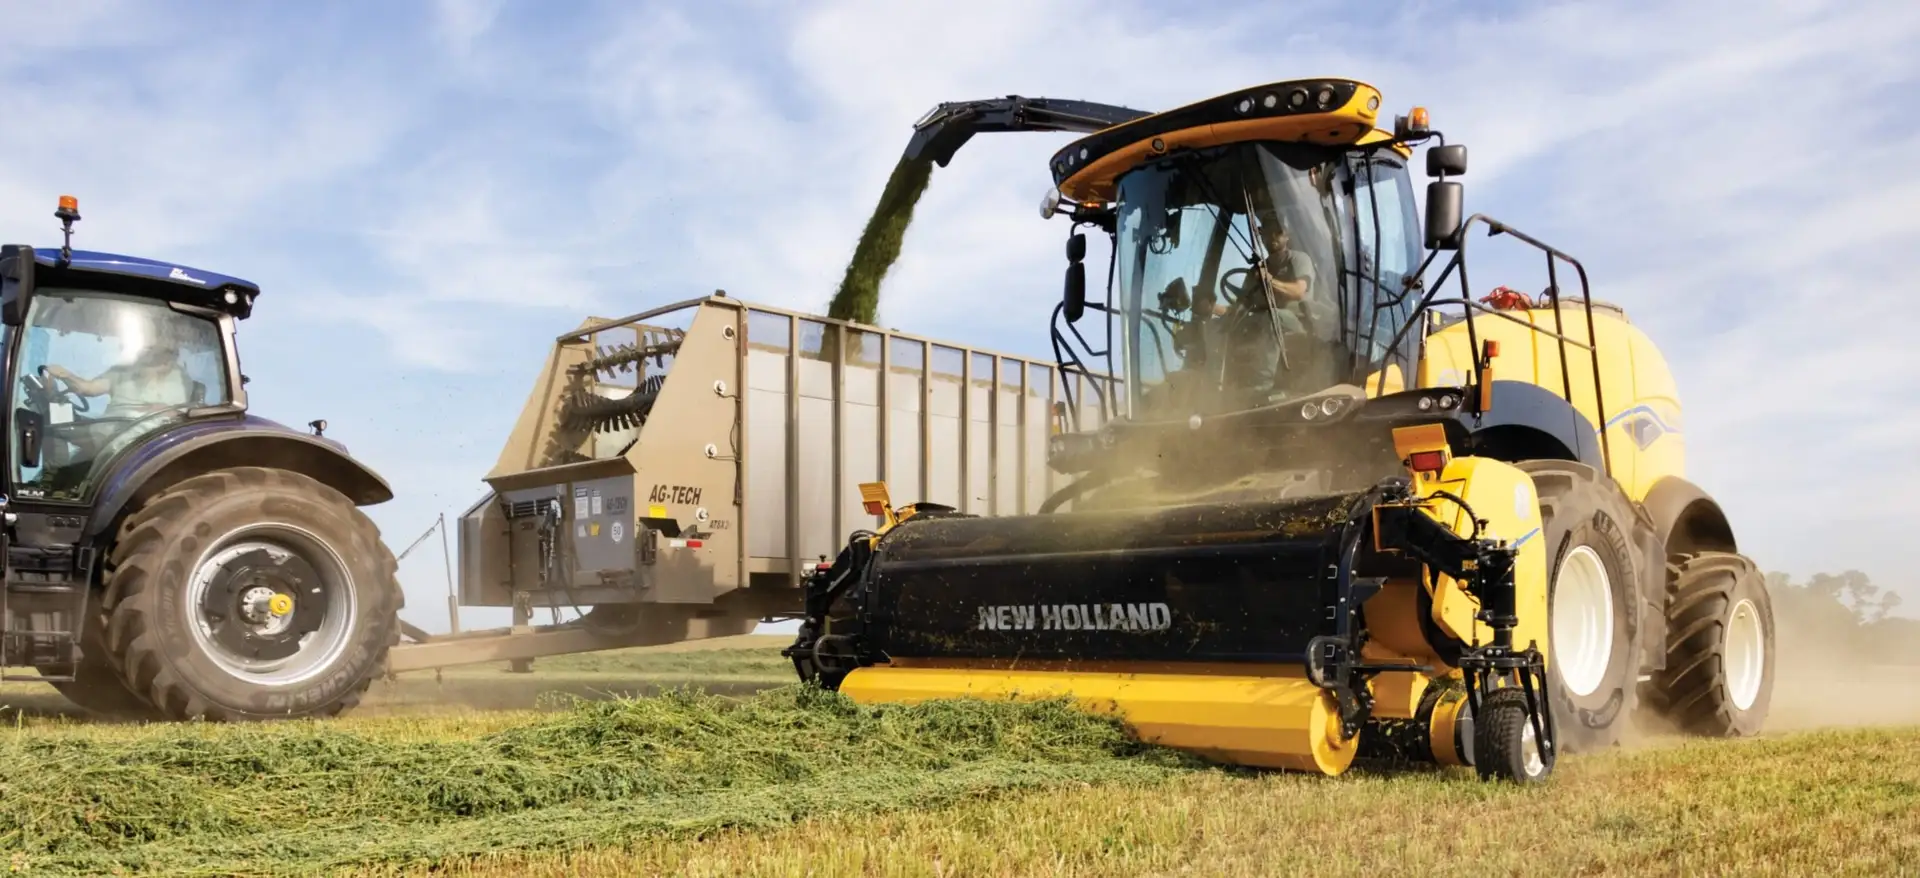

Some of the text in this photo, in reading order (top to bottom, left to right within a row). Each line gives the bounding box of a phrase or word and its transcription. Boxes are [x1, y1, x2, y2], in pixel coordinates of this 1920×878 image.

[649, 484, 702, 505] AG-TECH
[978, 602, 1171, 631] NEW HOLLAND
